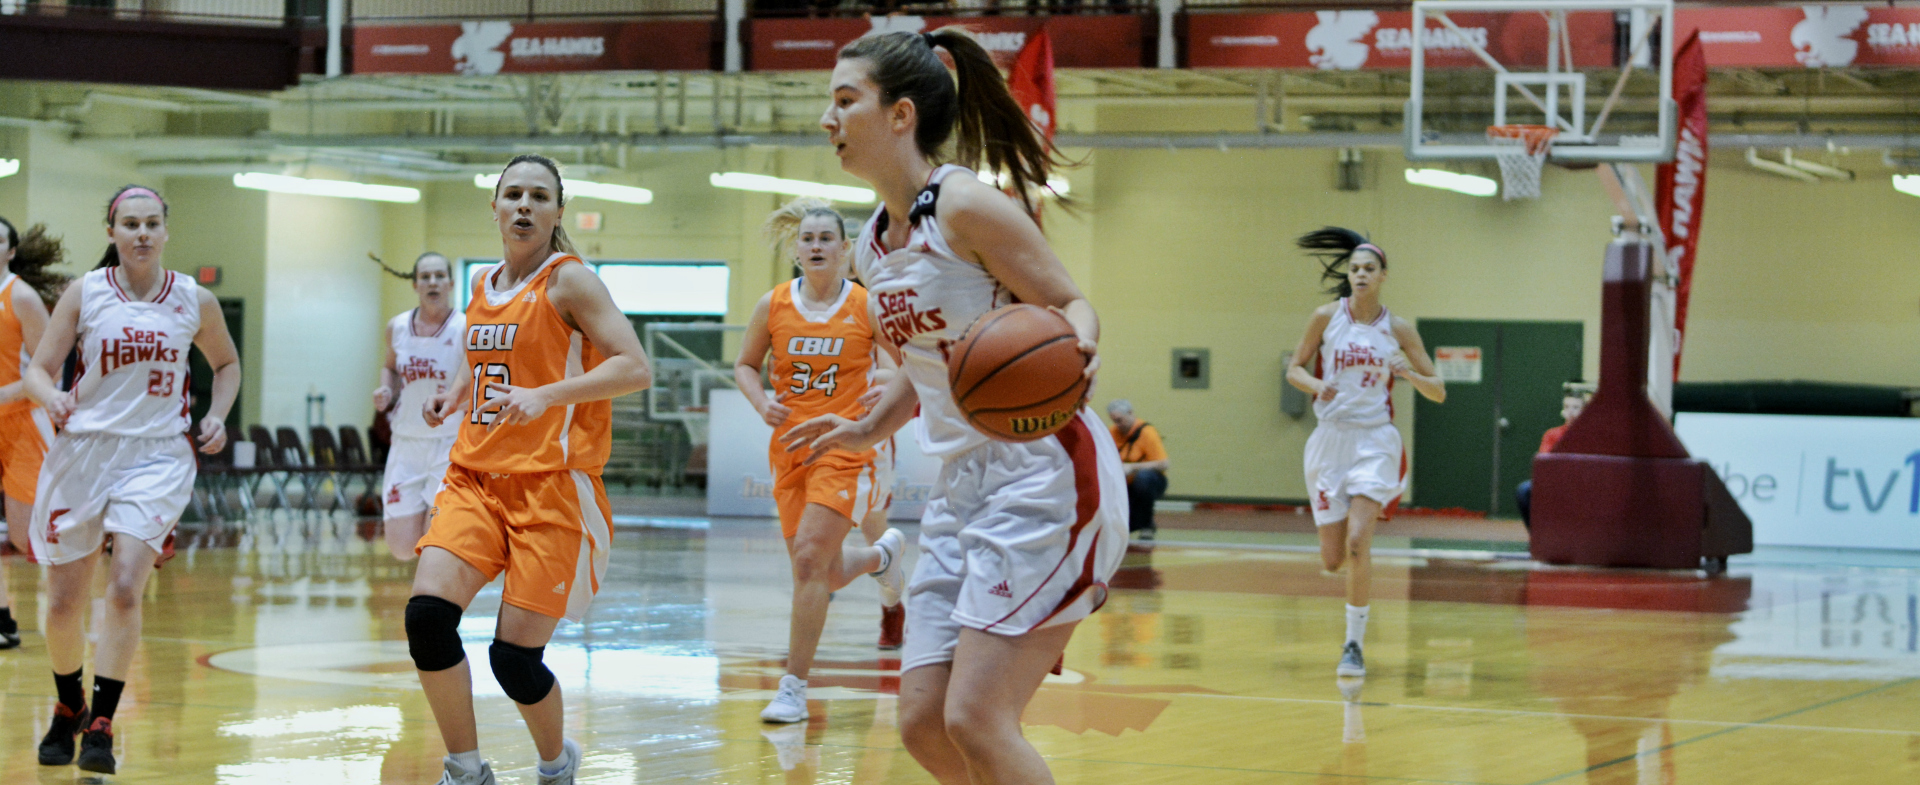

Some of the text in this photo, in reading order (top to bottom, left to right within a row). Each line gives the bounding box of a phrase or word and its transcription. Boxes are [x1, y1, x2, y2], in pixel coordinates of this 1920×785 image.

[466, 323, 519, 351] CBU
[787, 336, 845, 356] CBU
[100, 338, 179, 378] Hawks
[147, 368, 175, 397] 23
[790, 361, 839, 396] 34
